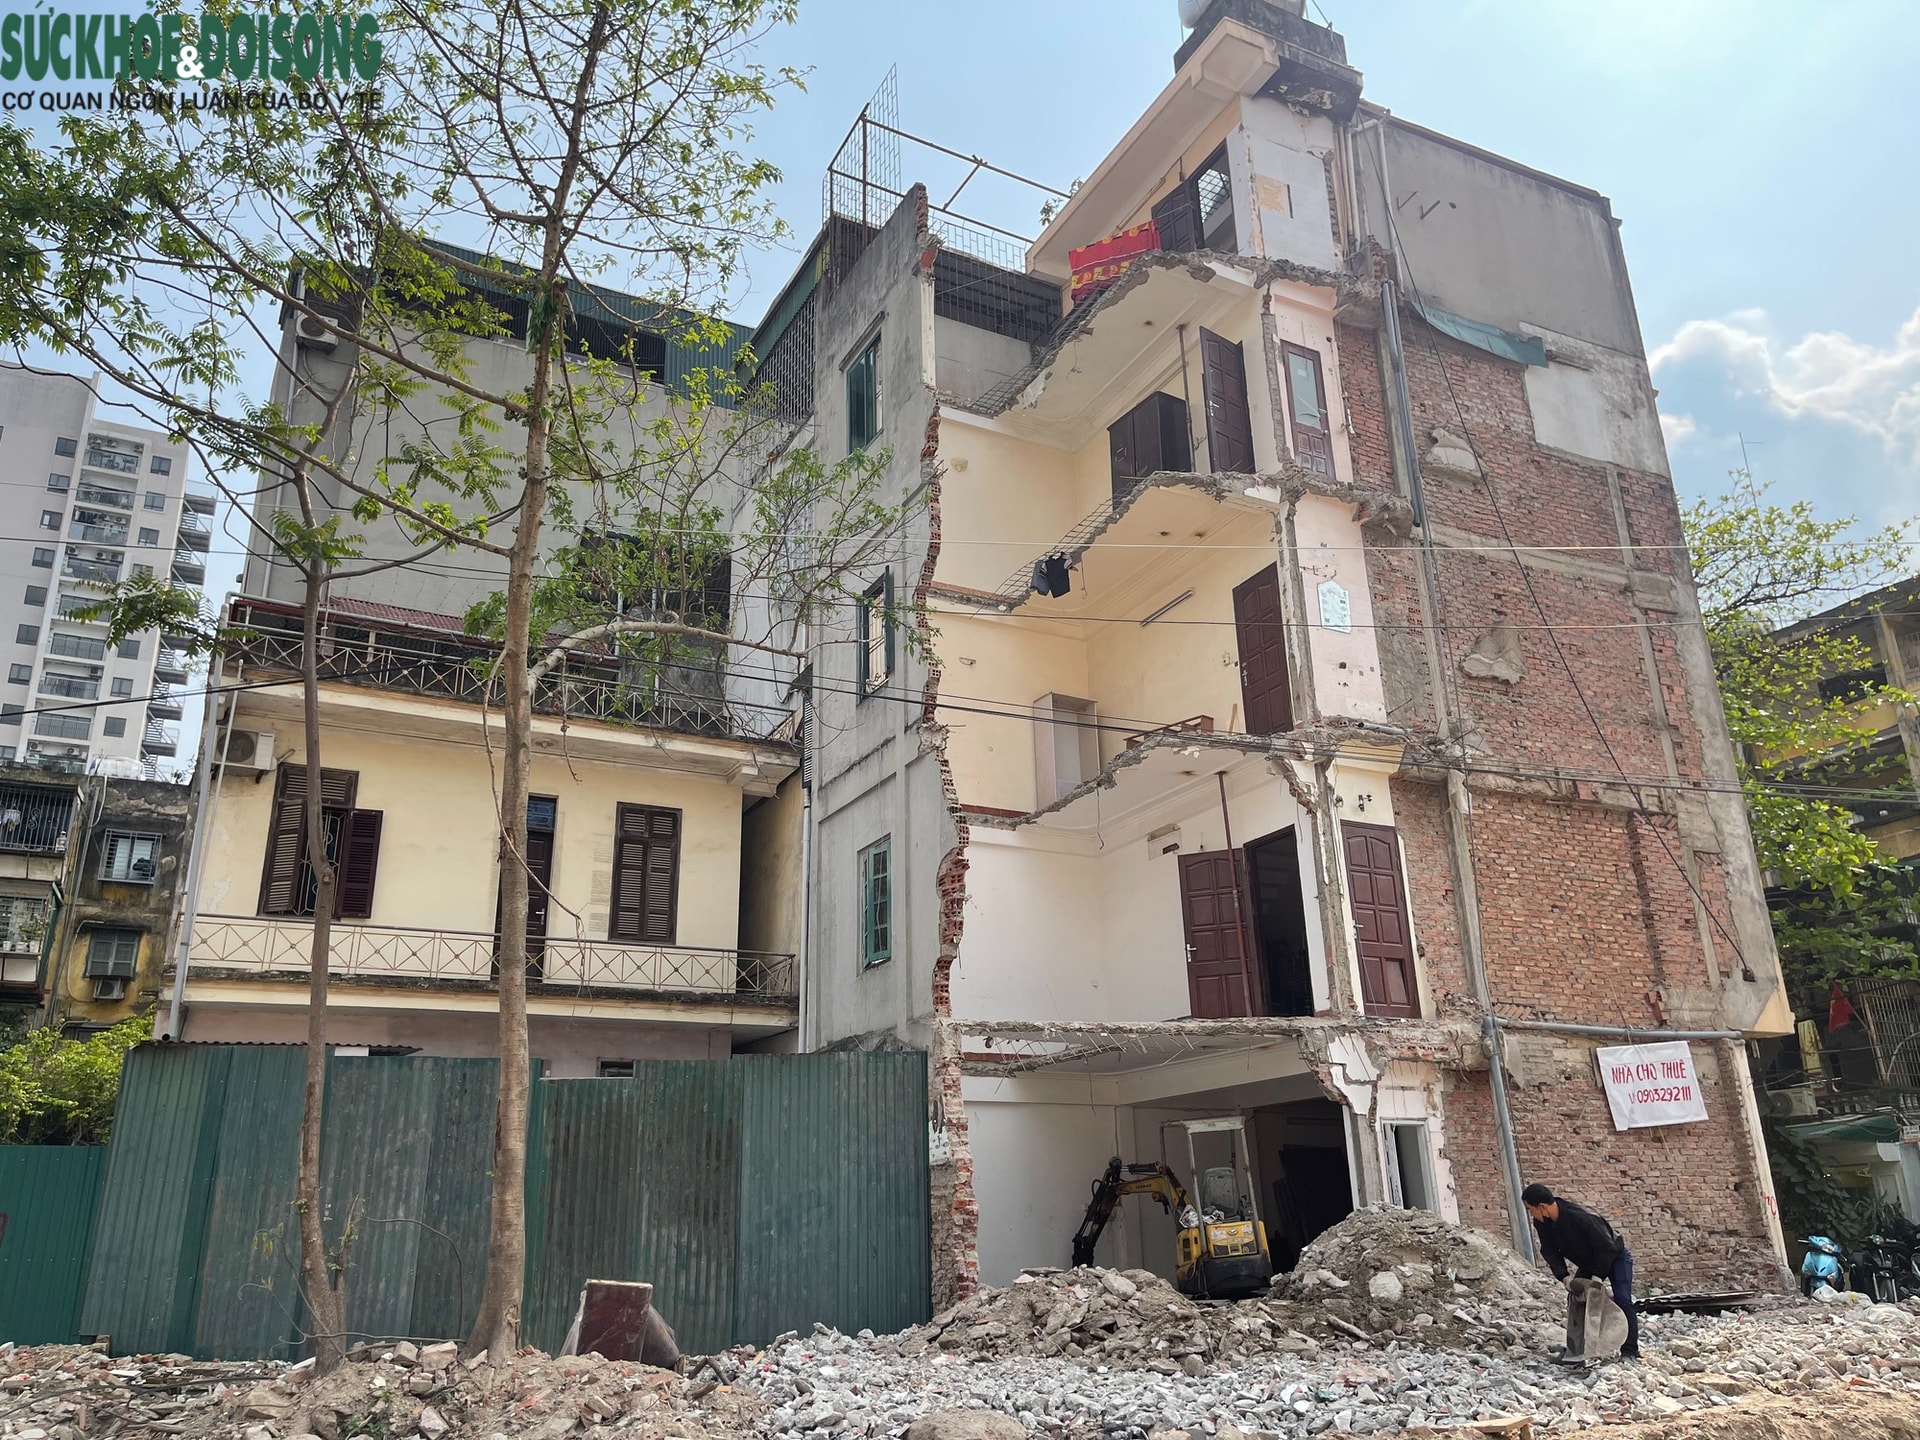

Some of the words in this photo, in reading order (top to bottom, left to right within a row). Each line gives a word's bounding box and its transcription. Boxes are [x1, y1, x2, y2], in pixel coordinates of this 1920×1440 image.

[1611, 1064, 1635, 1085] NHÀ
[1636, 1061, 1658, 1081] CHO
[1660, 1059, 1688, 1080] THUÊ
[1637, 1086, 1692, 1104] 0903292111
